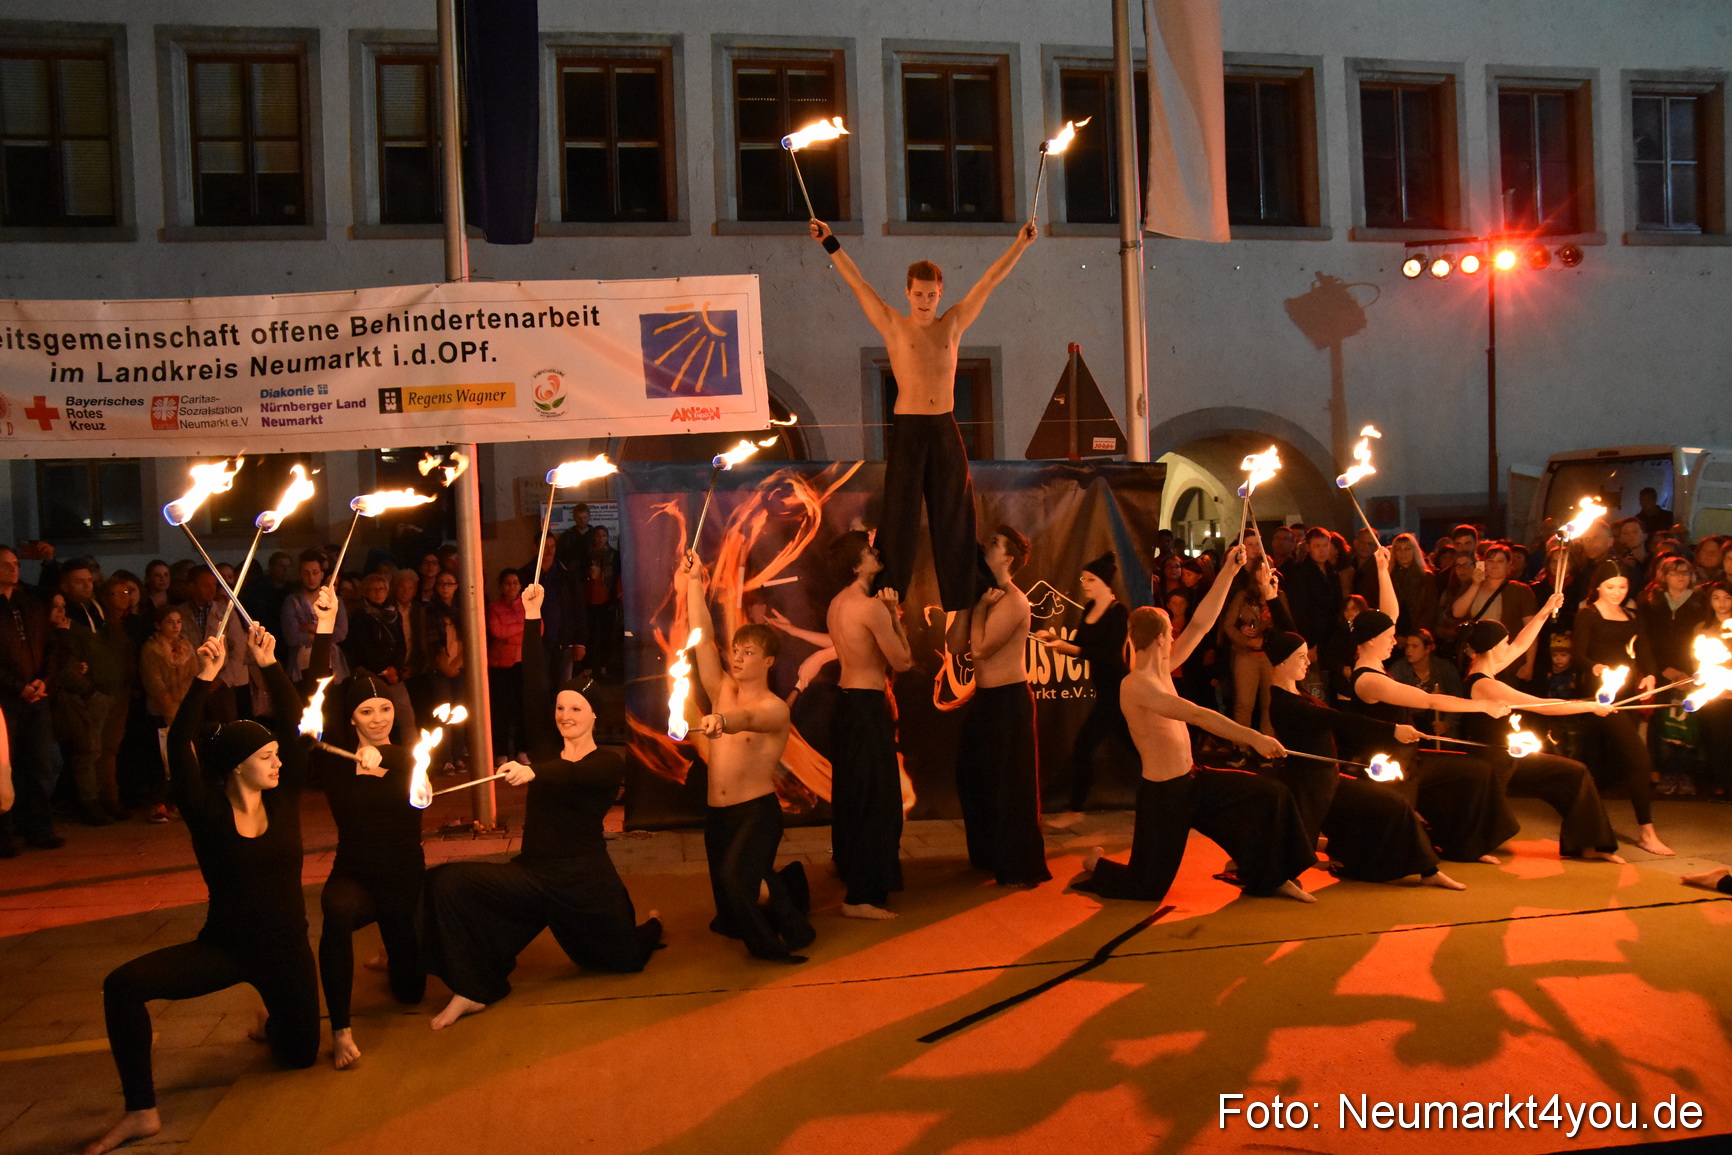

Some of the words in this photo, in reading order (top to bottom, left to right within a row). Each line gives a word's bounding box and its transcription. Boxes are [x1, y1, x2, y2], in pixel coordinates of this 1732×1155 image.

[0, 324, 240, 356] itsgemeinschaft
[251, 319, 339, 345] offene
[350, 305, 600, 338] Behindertenarbeit
[50, 362, 84, 383] im
[97, 358, 238, 383] Landkreis
[250, 346, 382, 377] Neumarkt
[393, 340, 497, 366] i.d.OPf.
[260, 385, 314, 399] Diakonie
[408, 391, 452, 408] Regens
[456, 388, 506, 405] Wagner
[66, 396, 144, 408] Bayerisches
[180, 395, 220, 404] Caritas-
[260, 402, 332, 413] Nürnberger
[336, 398, 366, 410] Land
[66, 408, 103, 419] Rotes
[179, 405, 242, 415] Sozialstation
[69, 420, 106, 431] Kreuz
[180, 419, 229, 429] Neumarkt
[261, 415, 323, 427] Neumarkt
[1061, 686, 1087, 699] e.V.
